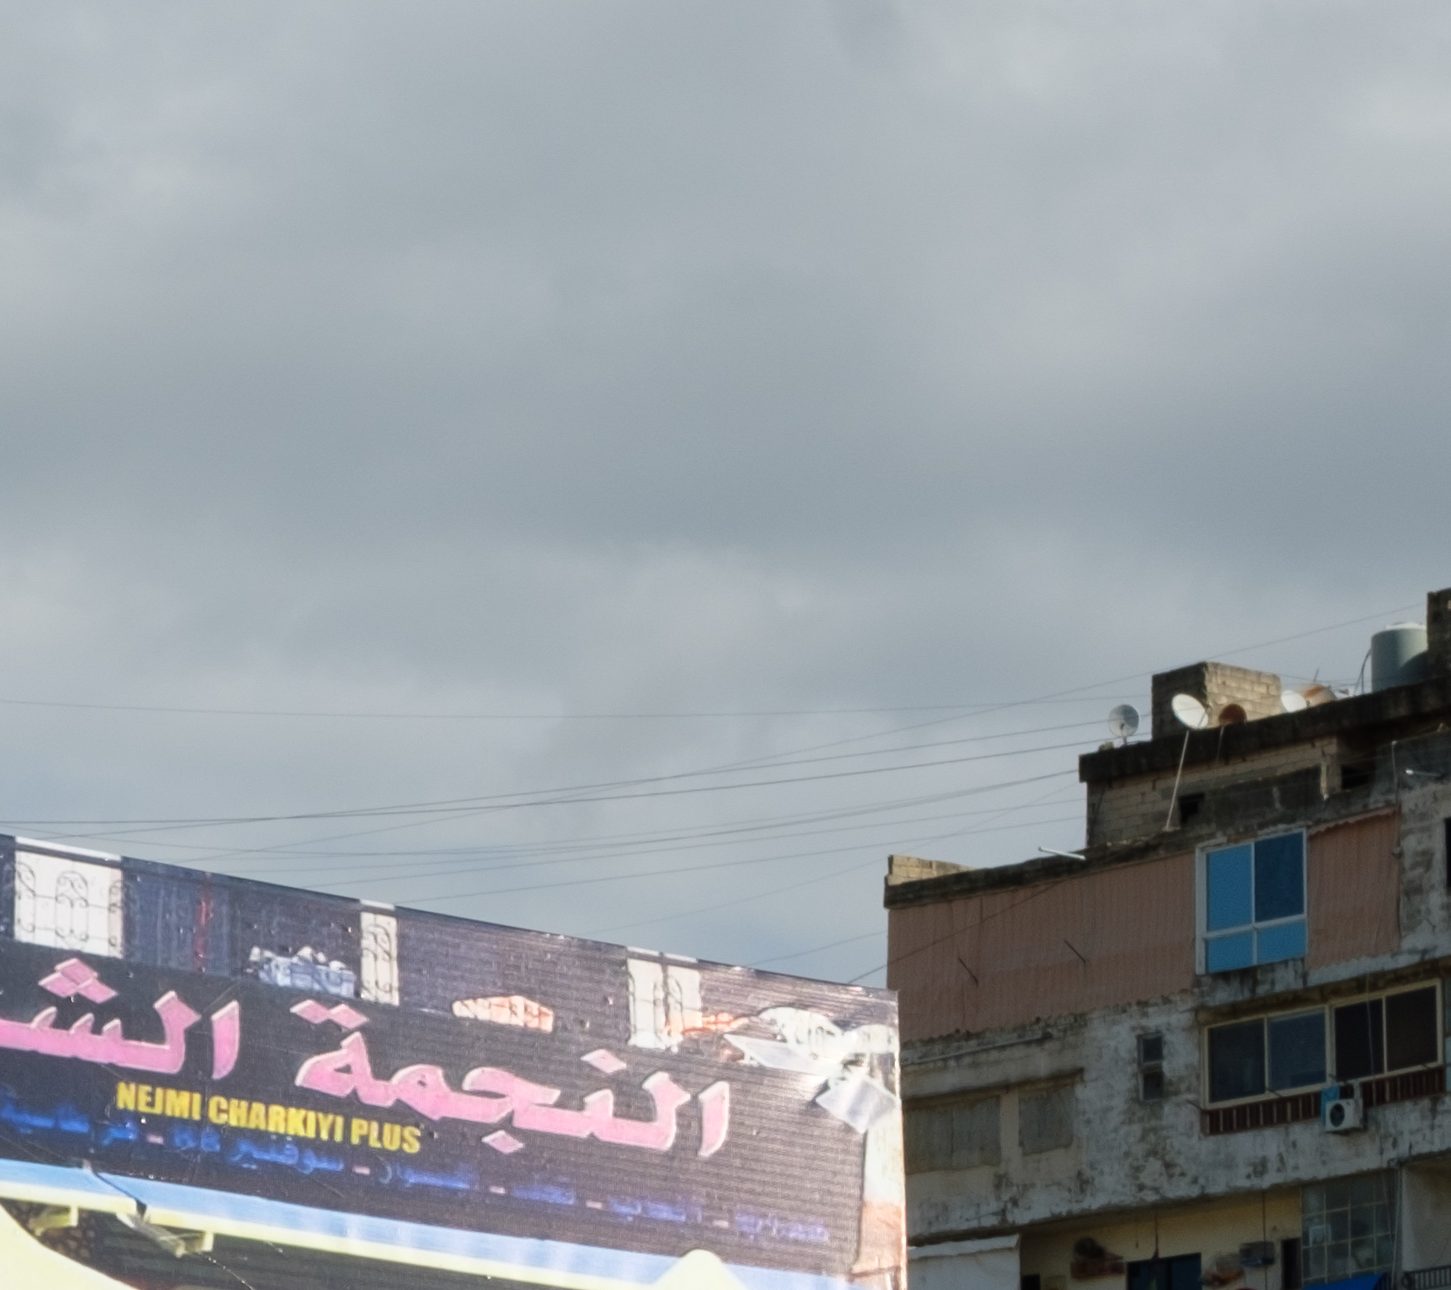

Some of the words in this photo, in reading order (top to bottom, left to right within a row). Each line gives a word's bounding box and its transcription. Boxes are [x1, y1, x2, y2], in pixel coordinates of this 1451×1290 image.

[116, 1081, 202, 1121] NEJMI
[208, 1095, 345, 1143] CHARKIYI
[350, 1117, 422, 1154] PLUS
[291, 1000, 730, 1157] النجمة
